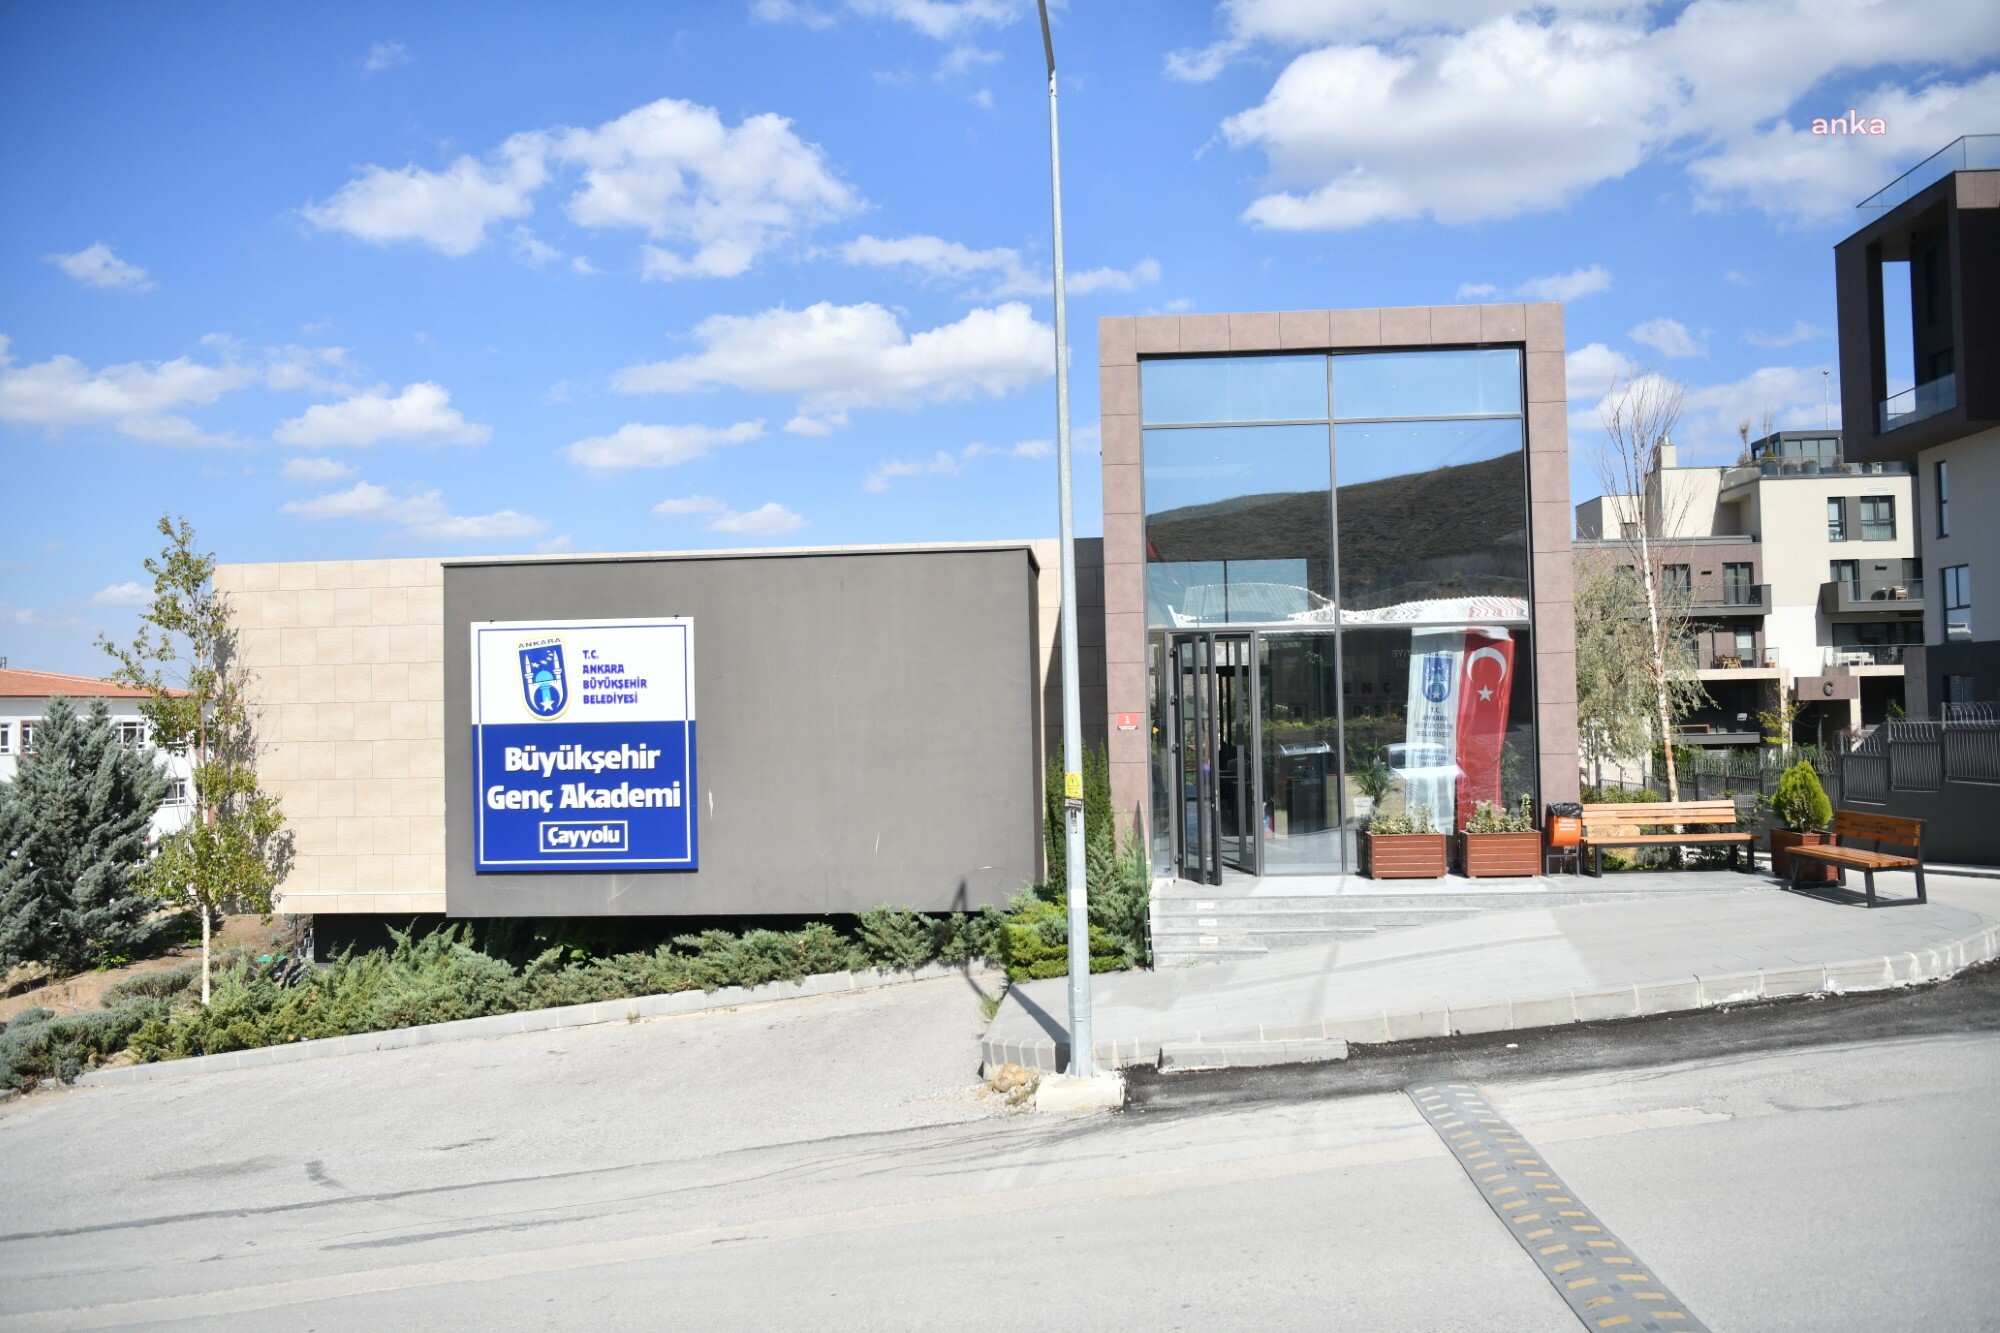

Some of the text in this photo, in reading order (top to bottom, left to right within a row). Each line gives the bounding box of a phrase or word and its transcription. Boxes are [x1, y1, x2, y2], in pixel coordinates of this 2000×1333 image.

[518, 637, 562, 649] ANKARA
[582, 649, 600, 660] T.C.
[582, 664, 625, 674] ANKARA
[582, 676, 648, 690] BÜYÜKŞEHİR
[1823, 681, 1834, 697] C
[582, 691, 639, 705] BELEDİYESİ
[1124, 715, 1131, 725] 1
[504, 743, 661, 778] Büyükşehir
[487, 780, 681, 813] Genç Akademi
[547, 825, 621, 848] Çayyolu
